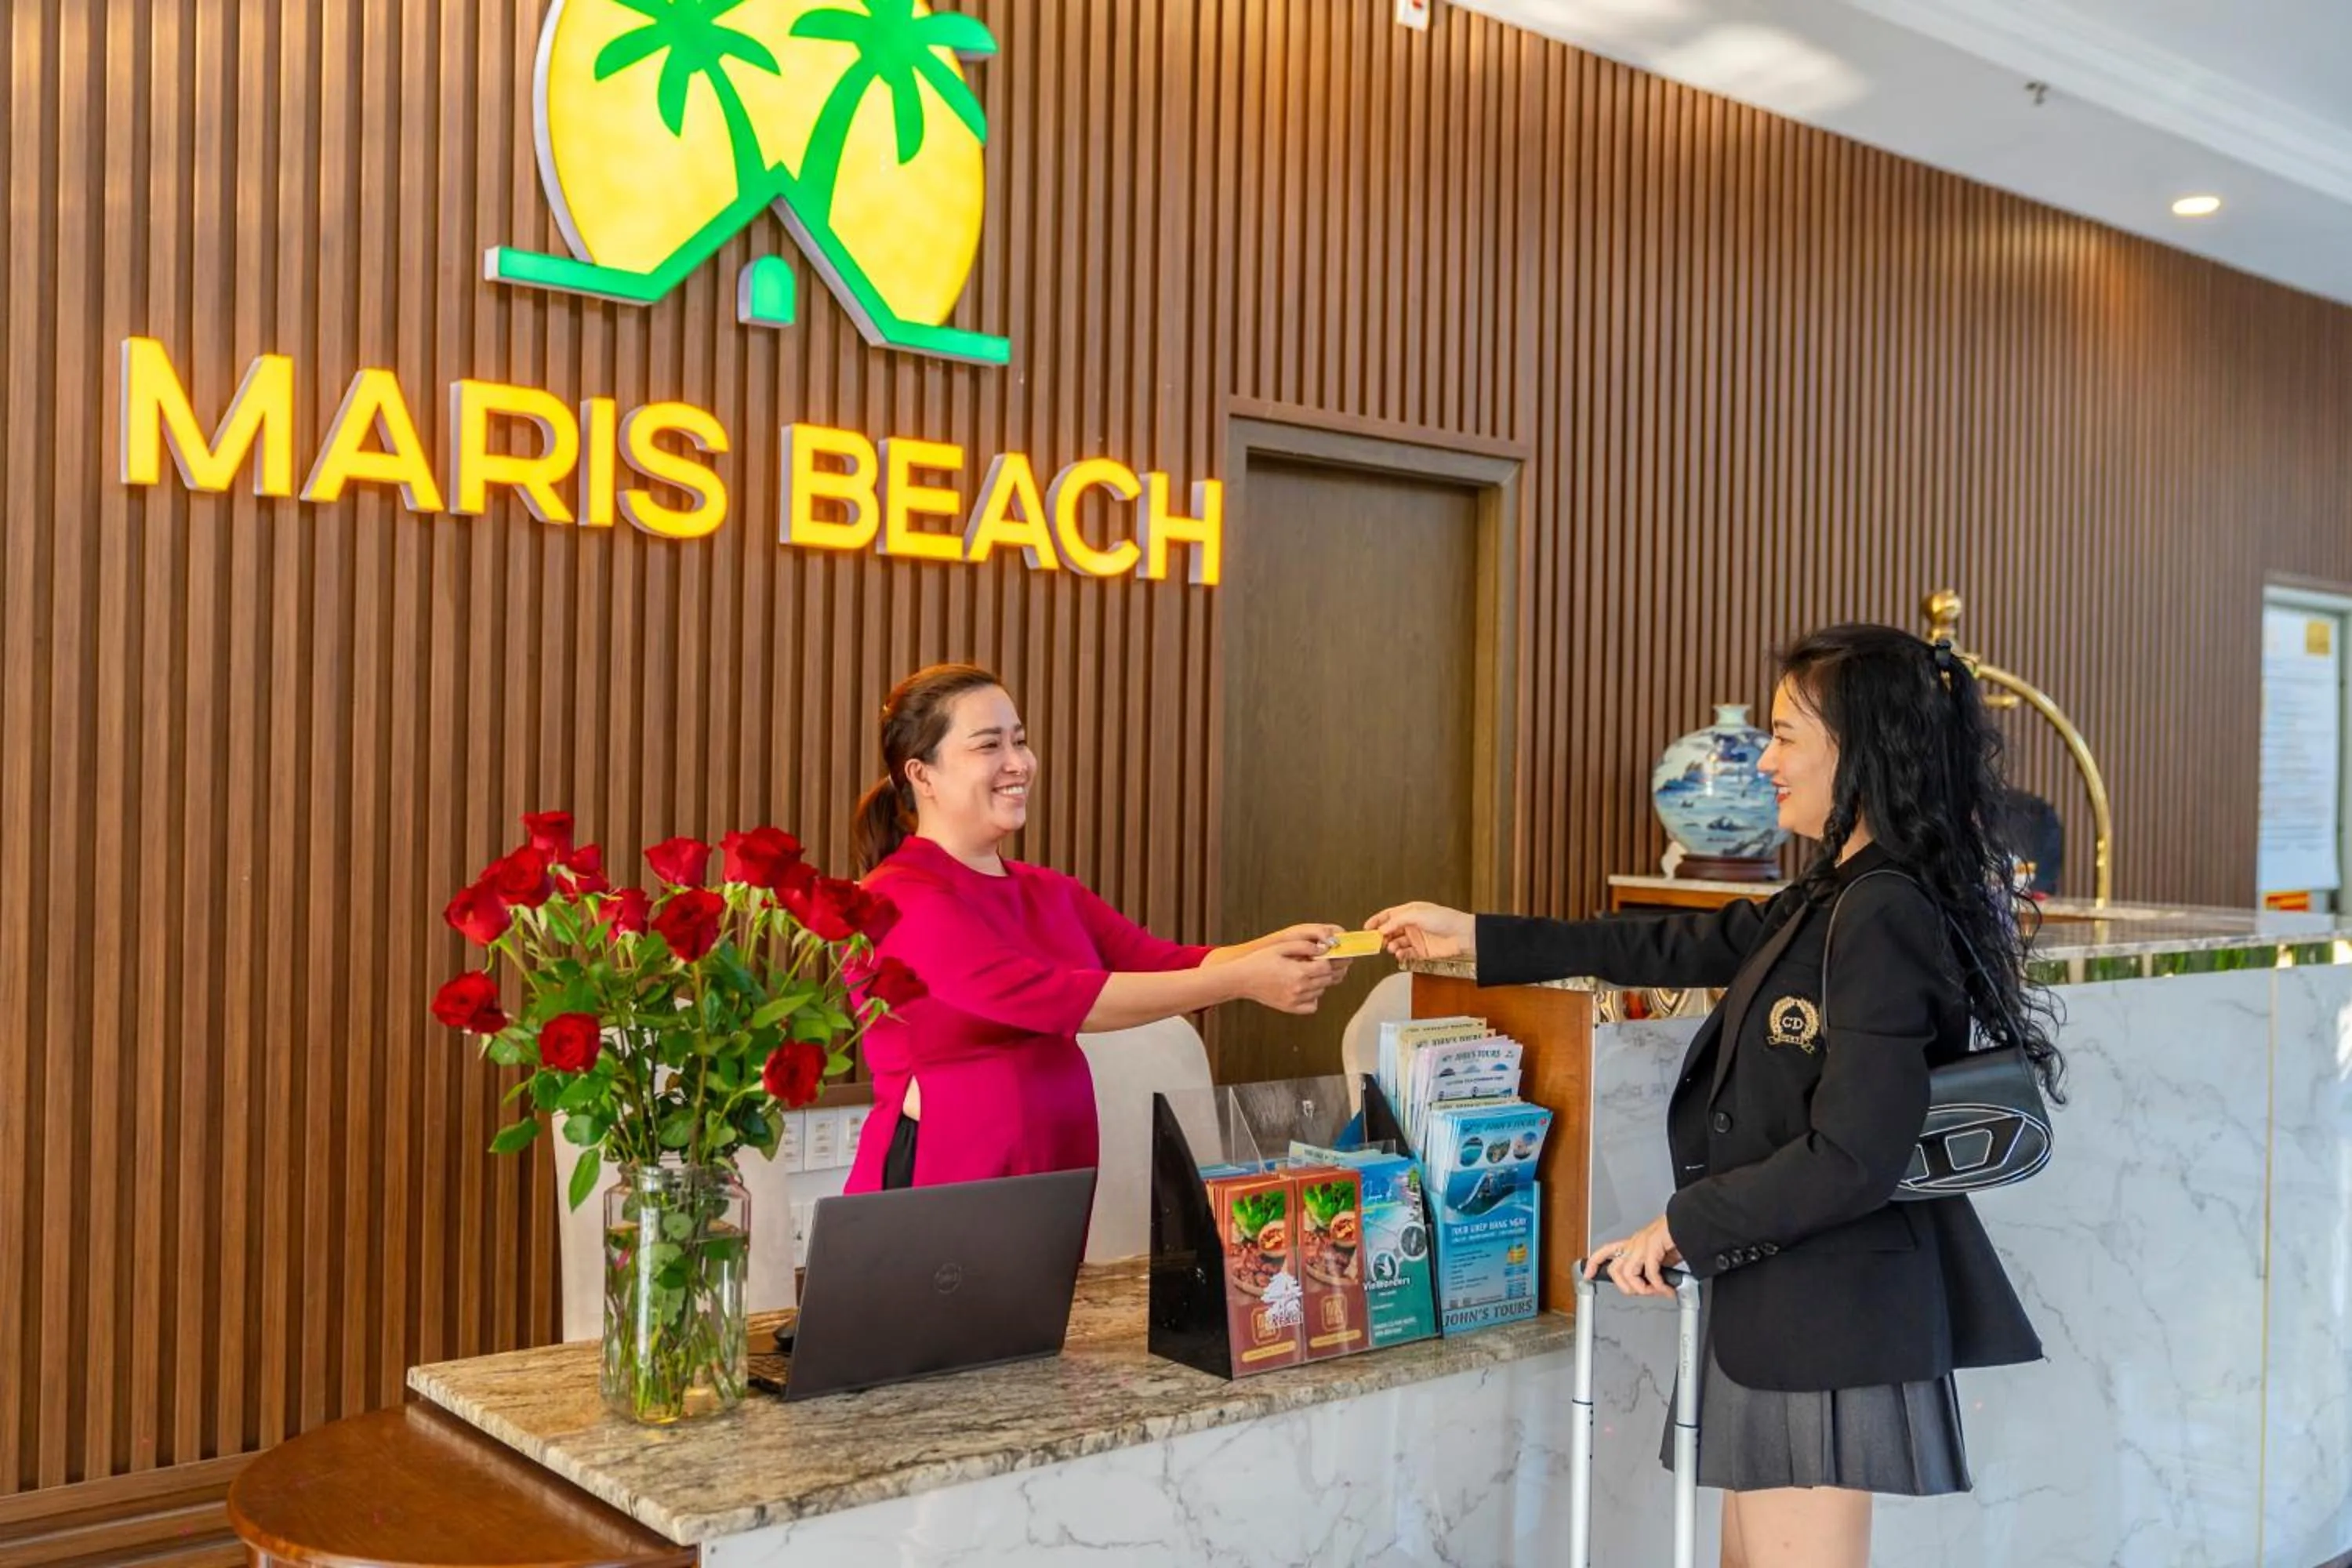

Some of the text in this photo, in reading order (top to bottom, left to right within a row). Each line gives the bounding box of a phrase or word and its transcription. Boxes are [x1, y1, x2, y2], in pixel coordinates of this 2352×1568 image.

[121, 337, 1223, 586] MARIS BEACH
[1782, 1016, 1803, 1029] CD
[1444, 1298, 1533, 1327] JOHN'S TOURS
